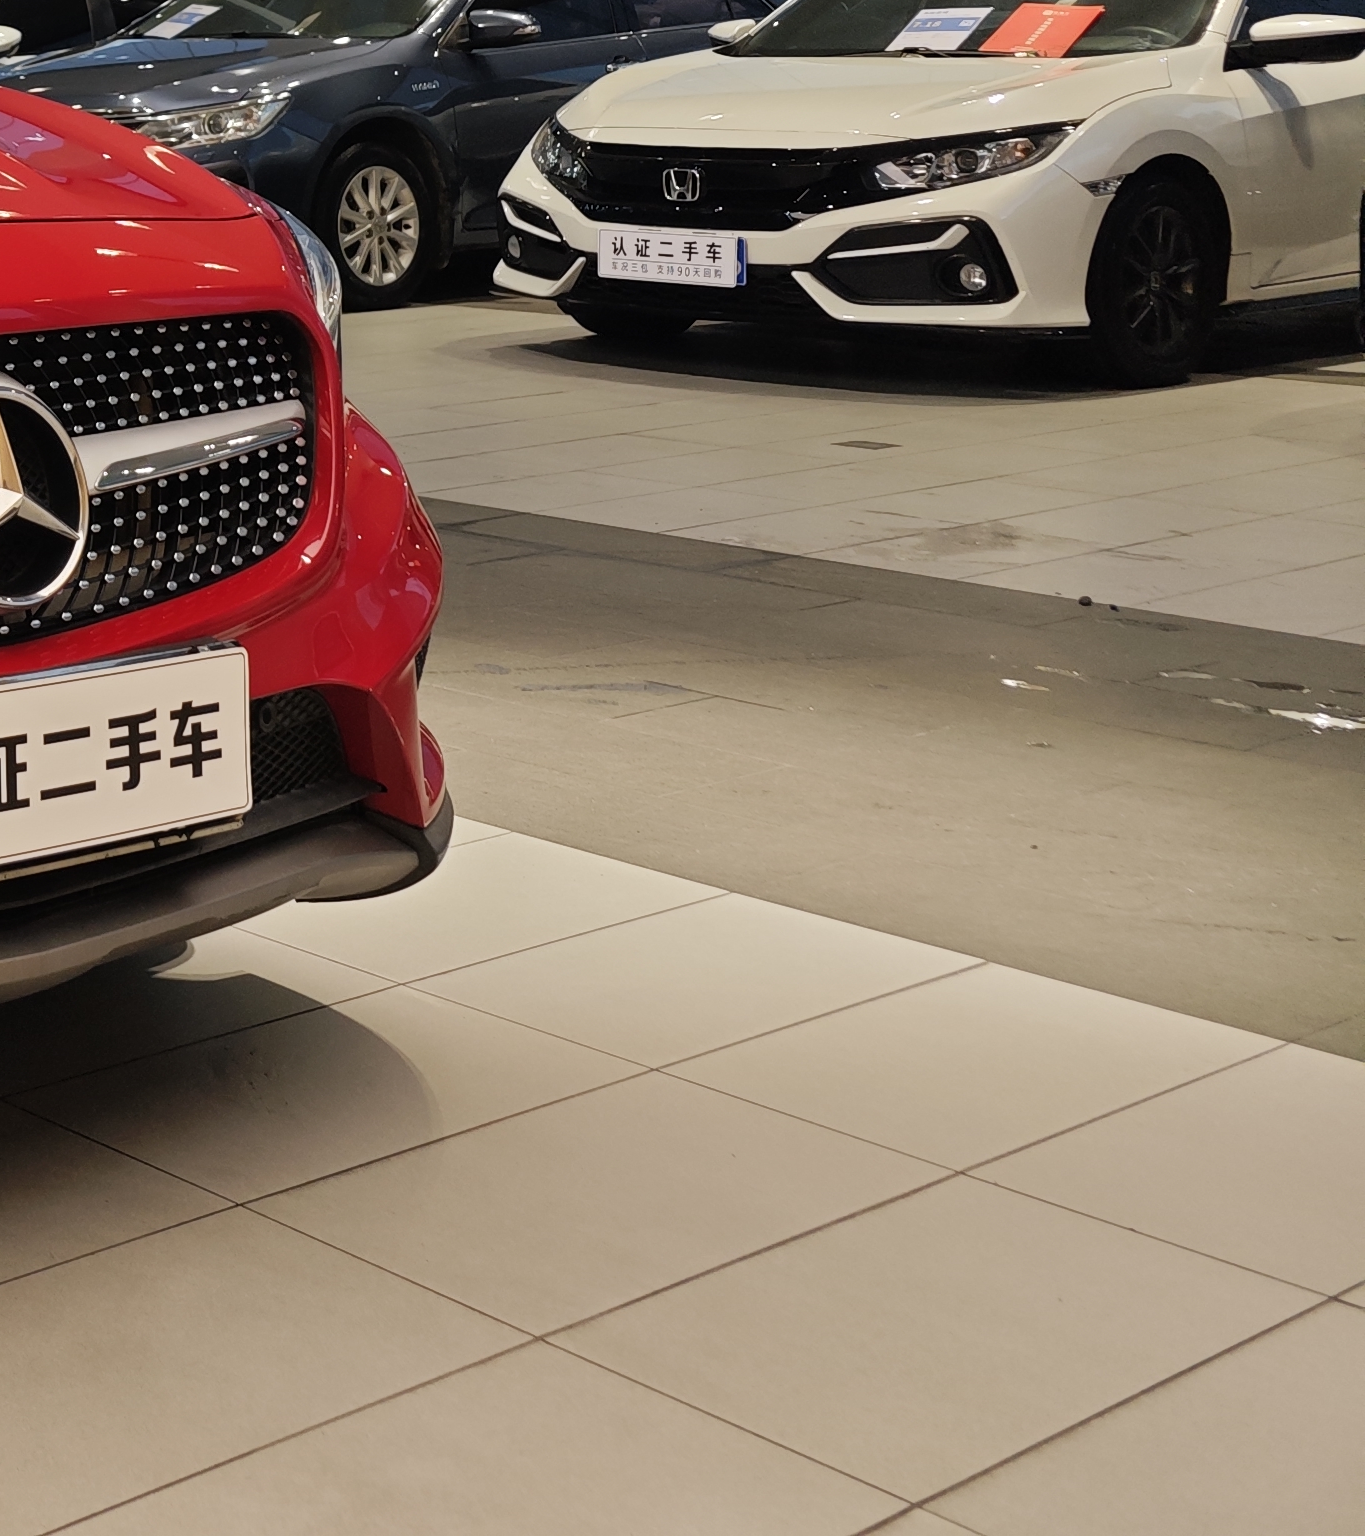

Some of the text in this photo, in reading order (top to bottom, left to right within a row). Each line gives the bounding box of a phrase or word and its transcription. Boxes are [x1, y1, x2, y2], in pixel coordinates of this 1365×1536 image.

[611, 236, 723, 264] 认证二手车
[656, 264, 723, 279] 支持90天回购
